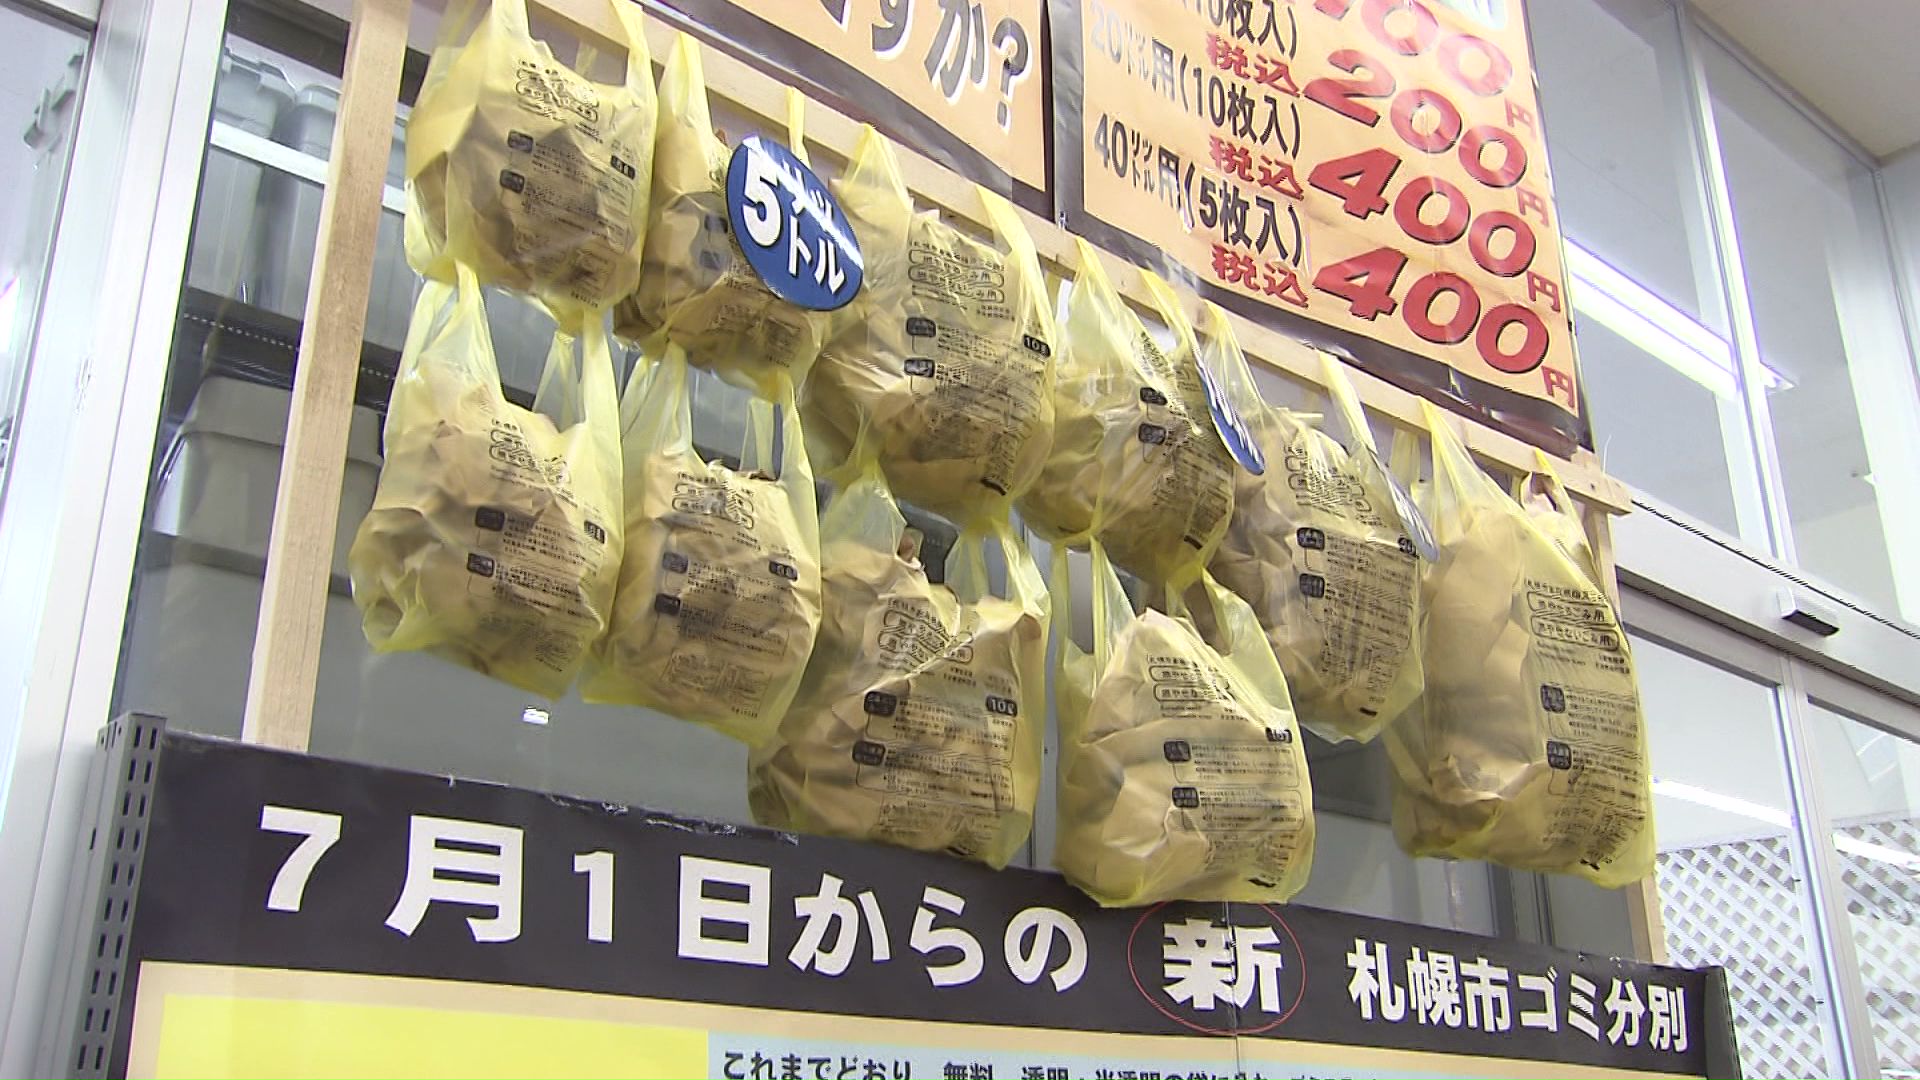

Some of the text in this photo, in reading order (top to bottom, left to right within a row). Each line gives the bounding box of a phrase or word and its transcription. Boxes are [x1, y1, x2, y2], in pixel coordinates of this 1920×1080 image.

[1206, 31, 1549, 227] 税込 200円
[1314, 0, 1537, 142] 00円
[1209, 134, 1561, 312] 税込 400円
[1211, 243, 1309, 309] 税込
[1312, 246, 1575, 409] 400円
[1162, 916, 1283, 1014] 新
[1346, 937, 1689, 1053] 札幌市ゴミ分別
